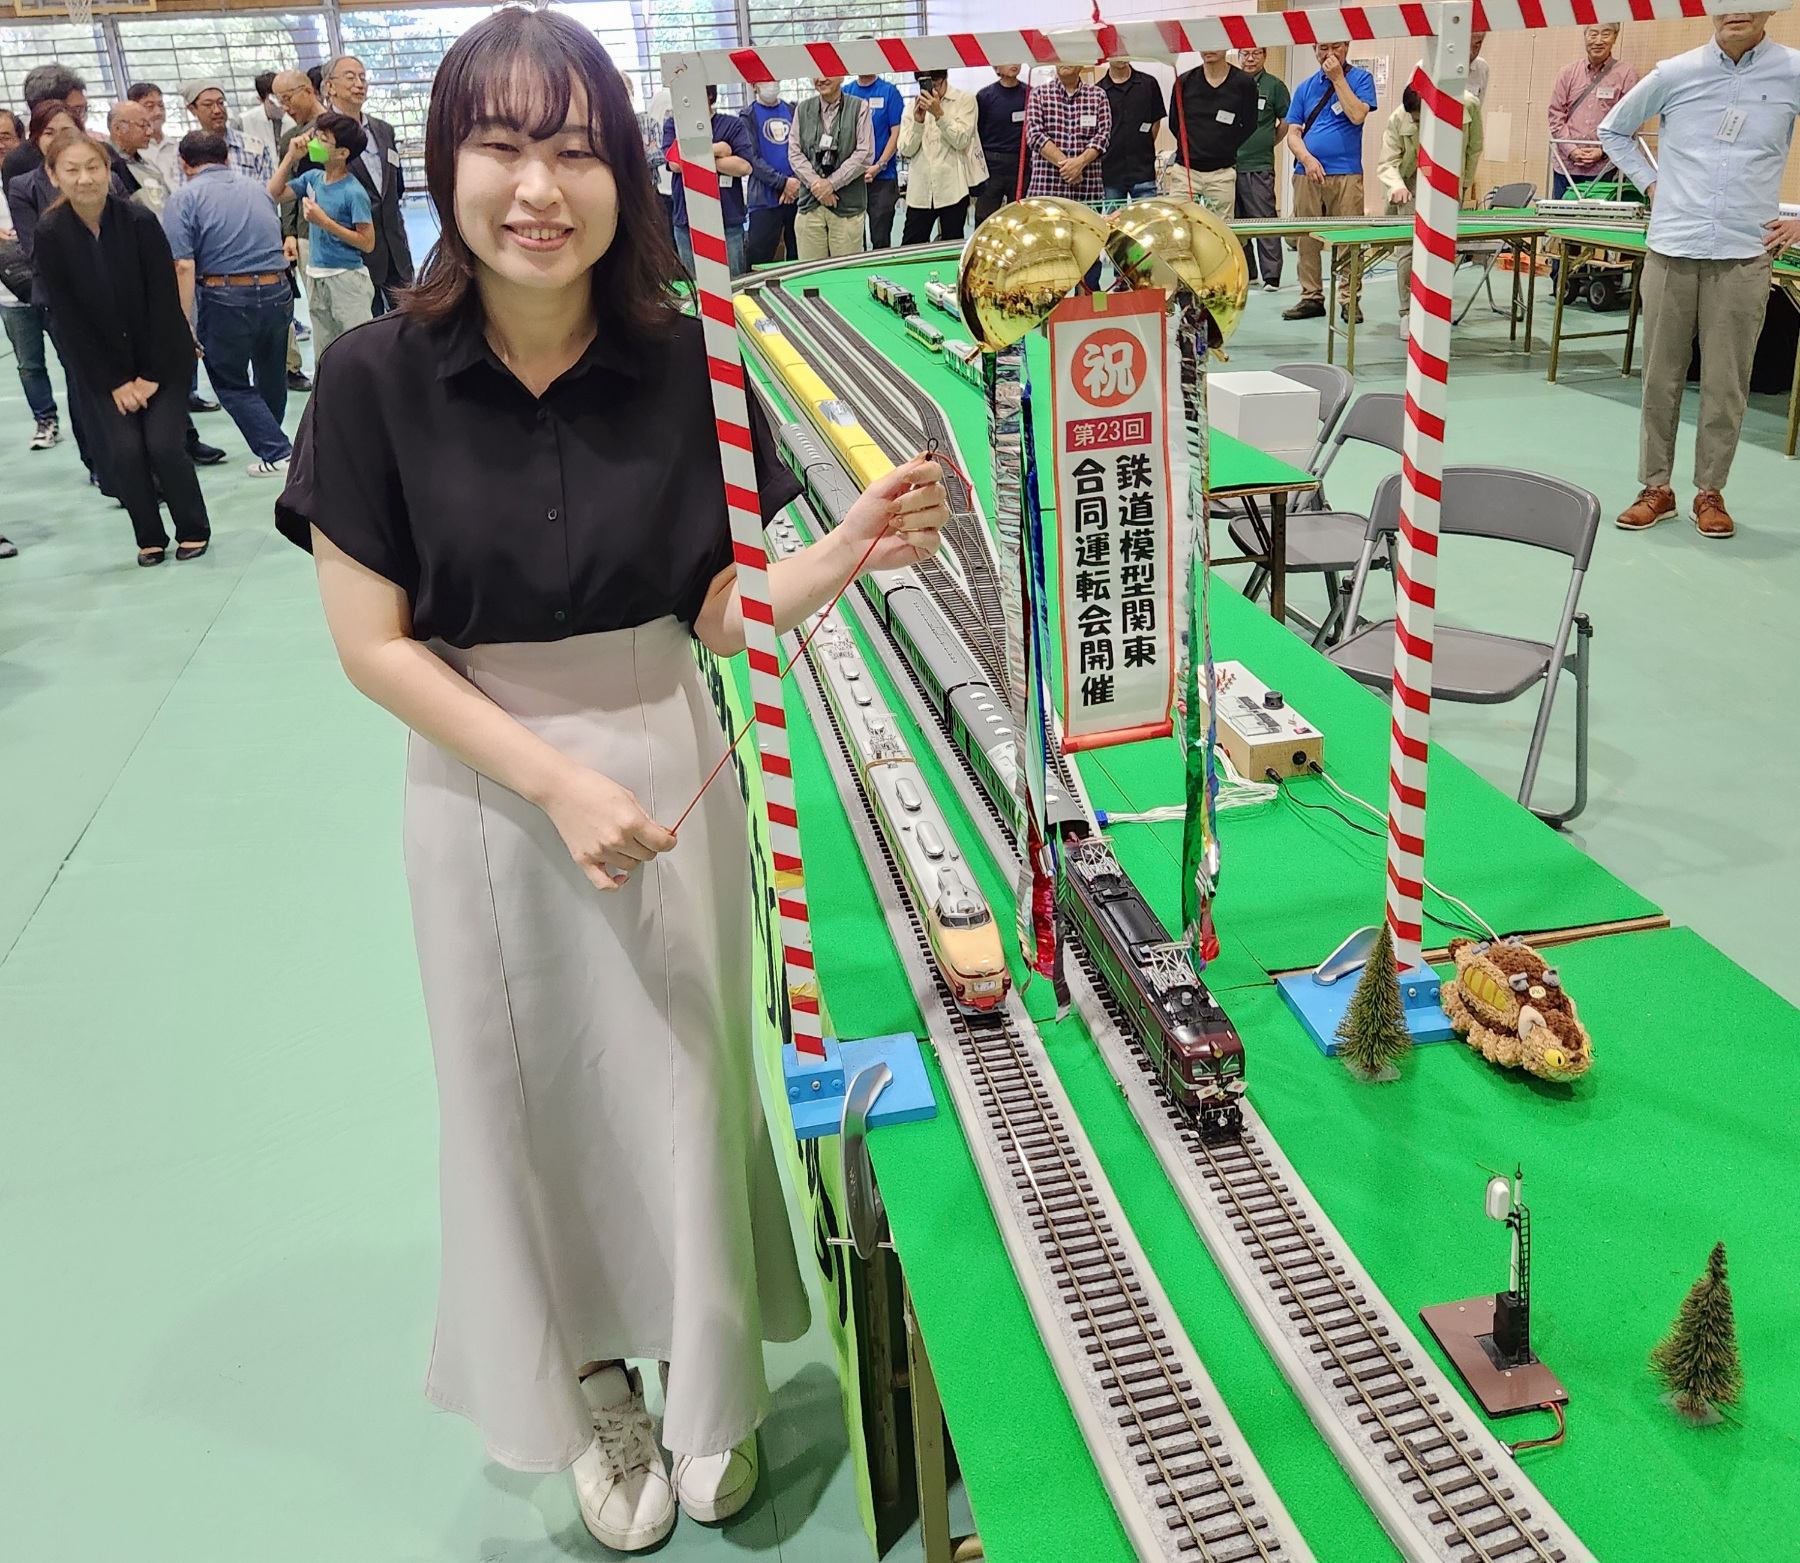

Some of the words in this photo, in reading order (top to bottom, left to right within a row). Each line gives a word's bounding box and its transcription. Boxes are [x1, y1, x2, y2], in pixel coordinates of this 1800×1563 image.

[1072, 417, 1146, 448] 第23回
[1083, 342, 1135, 399] 祝
[1071, 457, 1115, 707] 合同運転会開催
[1115, 453, 1157, 669] 鉄道模型関東
